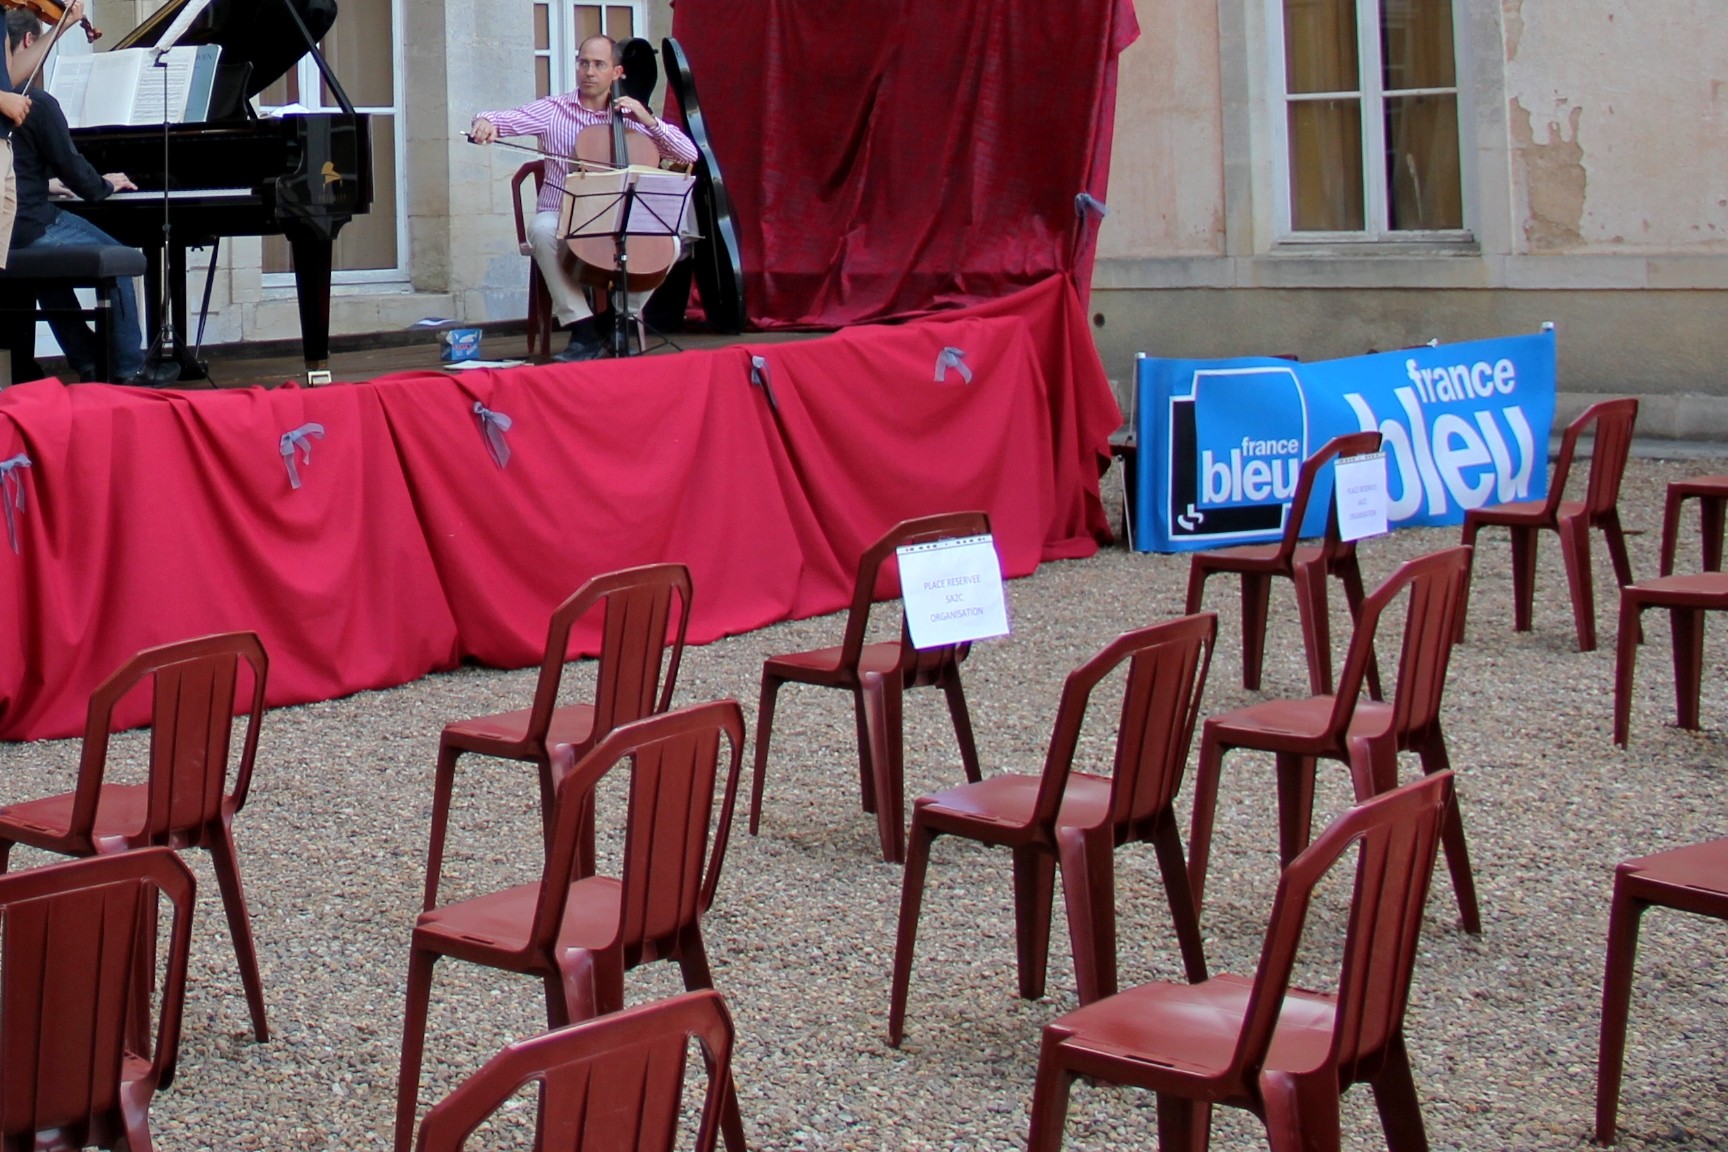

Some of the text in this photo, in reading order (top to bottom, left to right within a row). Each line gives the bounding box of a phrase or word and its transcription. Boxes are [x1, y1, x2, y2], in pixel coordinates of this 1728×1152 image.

[1406, 358, 1515, 404] france
[1241, 436, 1299, 456] france
[1201, 448, 1298, 504] bleu
[923, 574, 981, 590] PLACE RESERVEE
[945, 593, 964, 604] SA2C
[930, 607, 984, 623] ORGANISATION
